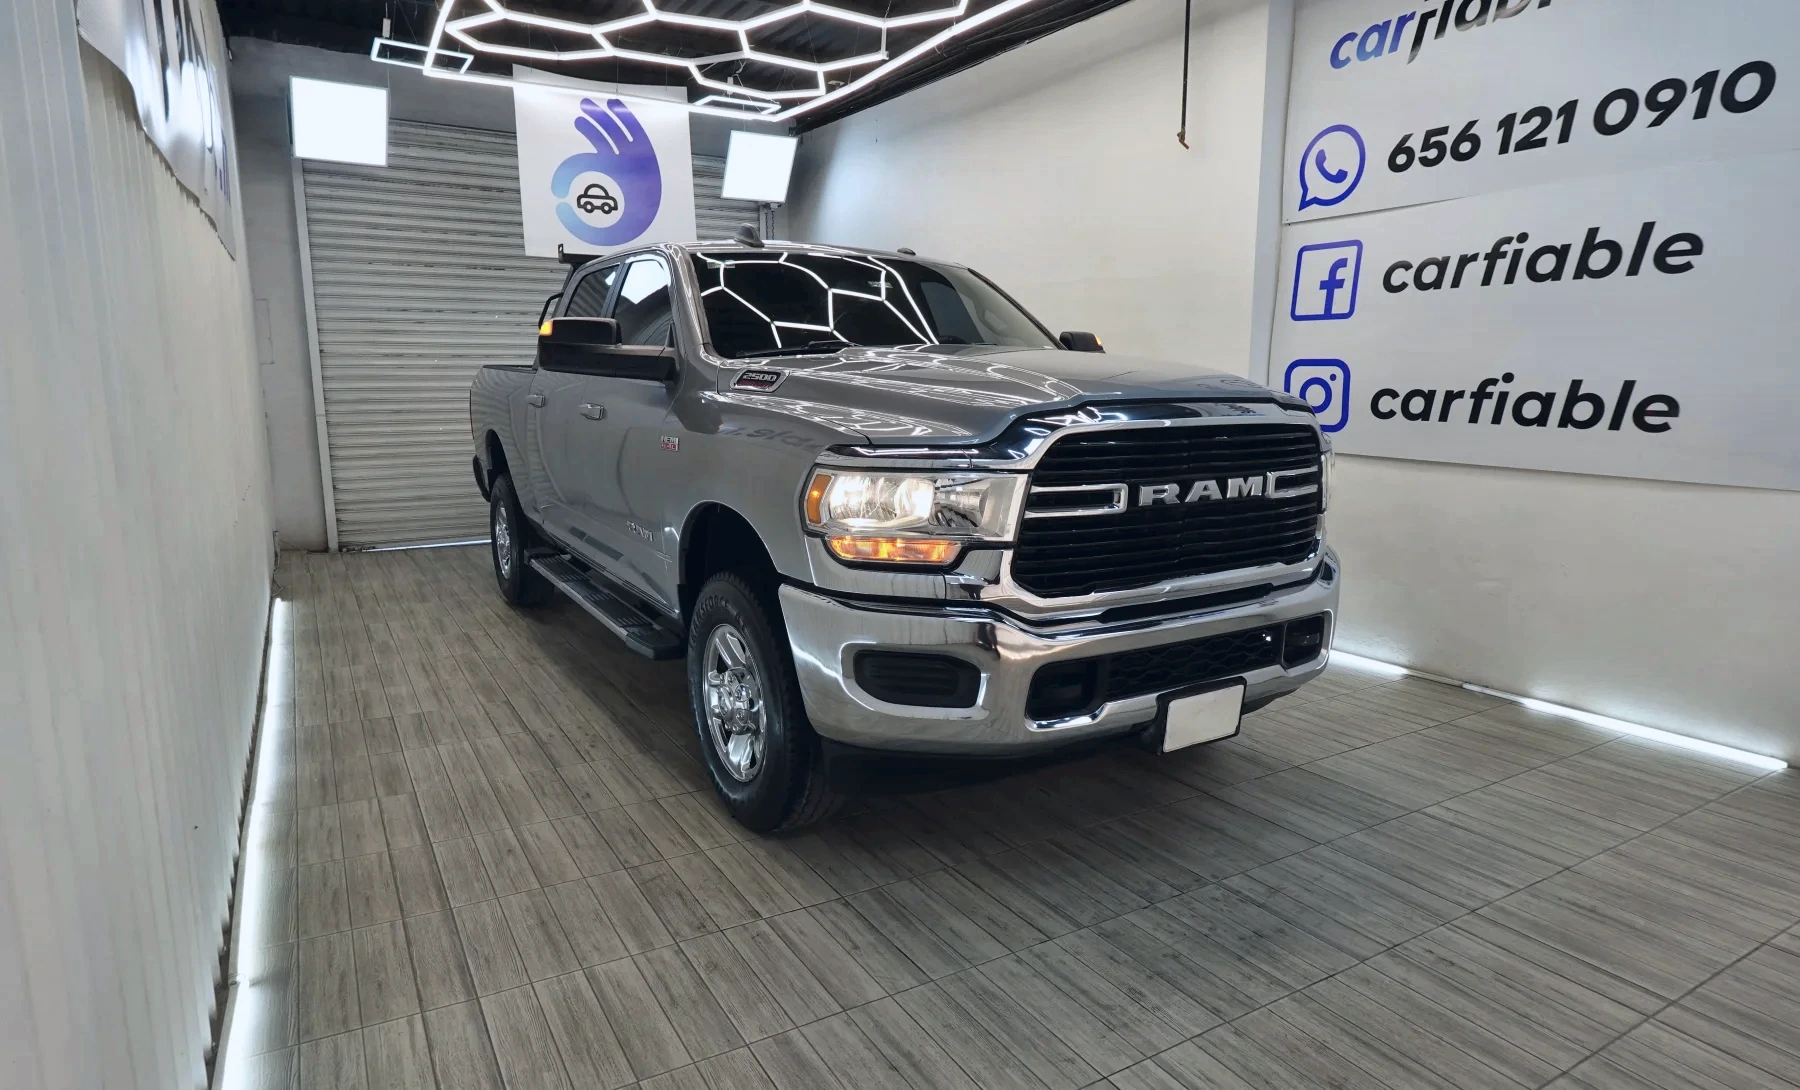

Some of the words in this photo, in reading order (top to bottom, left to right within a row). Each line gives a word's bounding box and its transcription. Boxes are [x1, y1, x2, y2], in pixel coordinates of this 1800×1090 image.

[1387, 119, 1481, 173] 656
[1496, 99, 1579, 155] 121
[1593, 60, 1777, 136] 0910
[1382, 221, 1704, 294] carfiable
[742, 372, 777, 382] 2500
[1369, 371, 1681, 434] carfiable
[1138, 475, 1262, 506] RAM
